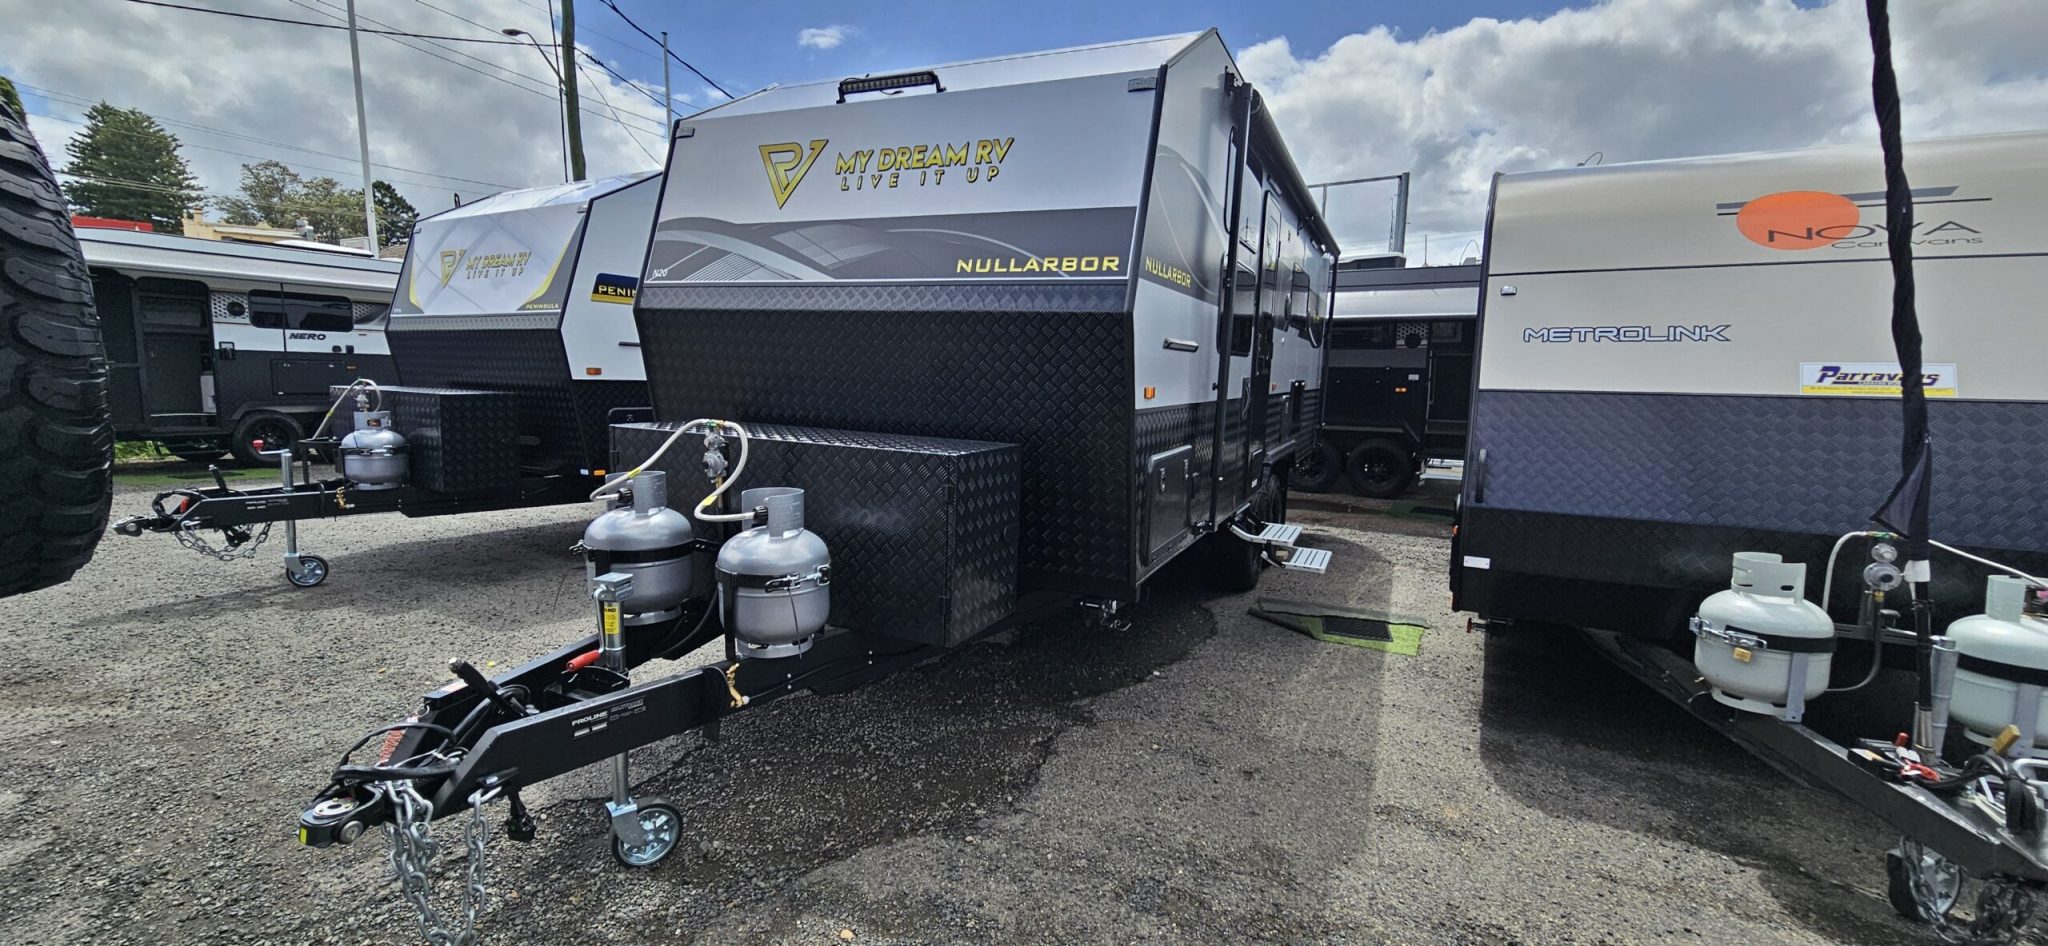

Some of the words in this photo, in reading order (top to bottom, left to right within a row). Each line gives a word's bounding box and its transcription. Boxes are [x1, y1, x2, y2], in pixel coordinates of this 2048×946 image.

[835, 149, 875, 175] MY
[877, 142, 970, 171] DREAM
[974, 137, 1015, 164] RV
[840, 173, 900, 191] LIVE
[919, 169, 945, 187] IT
[966, 165, 1000, 184] UP
[1831, 237, 1983, 249] Carvans
[465, 256, 483, 271] MY
[482, 253, 518, 269] DREAM
[516, 251, 532, 267] RV
[956, 256, 1121, 273] NULLARBOR
[466, 269, 490, 280] LIVE
[495, 268, 506, 278] IT
[511, 266, 525, 277] UP
[652, 268, 668, 278] N20
[1145, 256, 1192, 289] NULLARBOR
[525, 303, 559, 311] PENINSULA
[289, 332, 327, 341] NERO
[1523, 324, 1732, 343] METROLINK
[1816, 365, 1940, 387] Parravs
[571, 710, 608, 727] PROLINE
